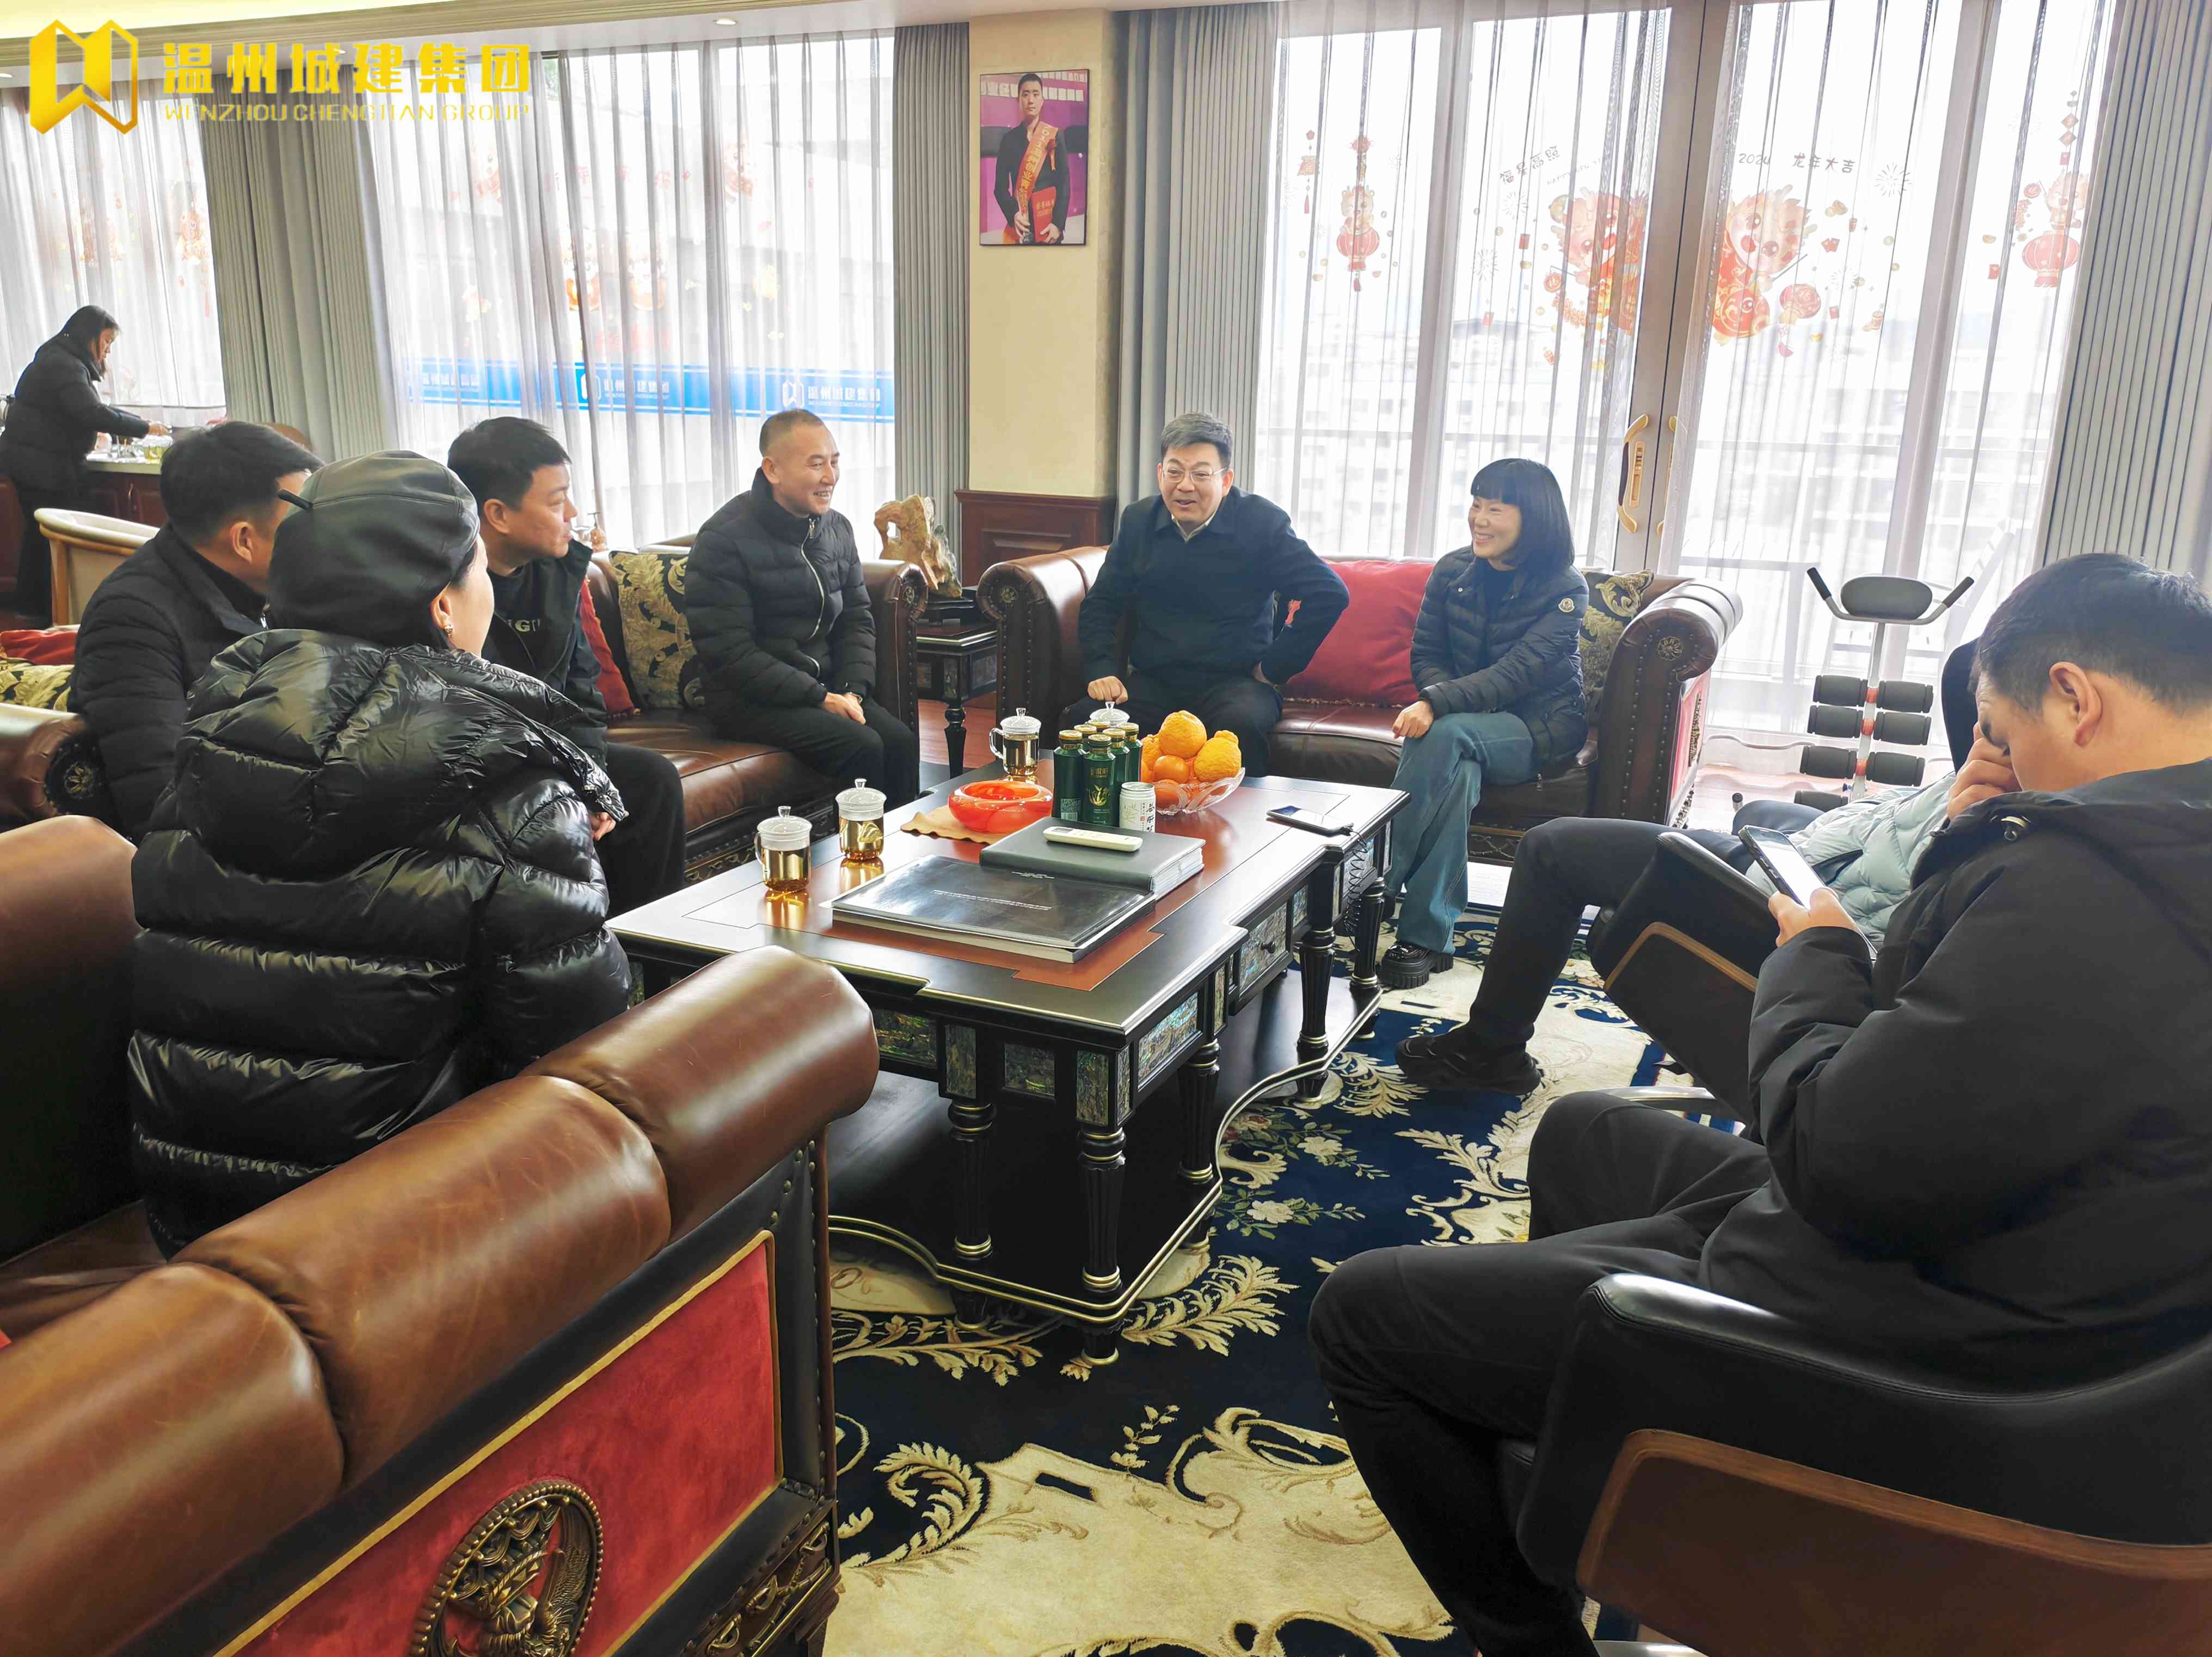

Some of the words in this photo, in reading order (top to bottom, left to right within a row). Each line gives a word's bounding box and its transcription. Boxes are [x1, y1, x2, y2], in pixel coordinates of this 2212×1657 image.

[1499, 145, 1559, 185] 福星高照
[1738, 153, 1769, 165] 2024
[1792, 152, 1855, 173] 龙年大吉
